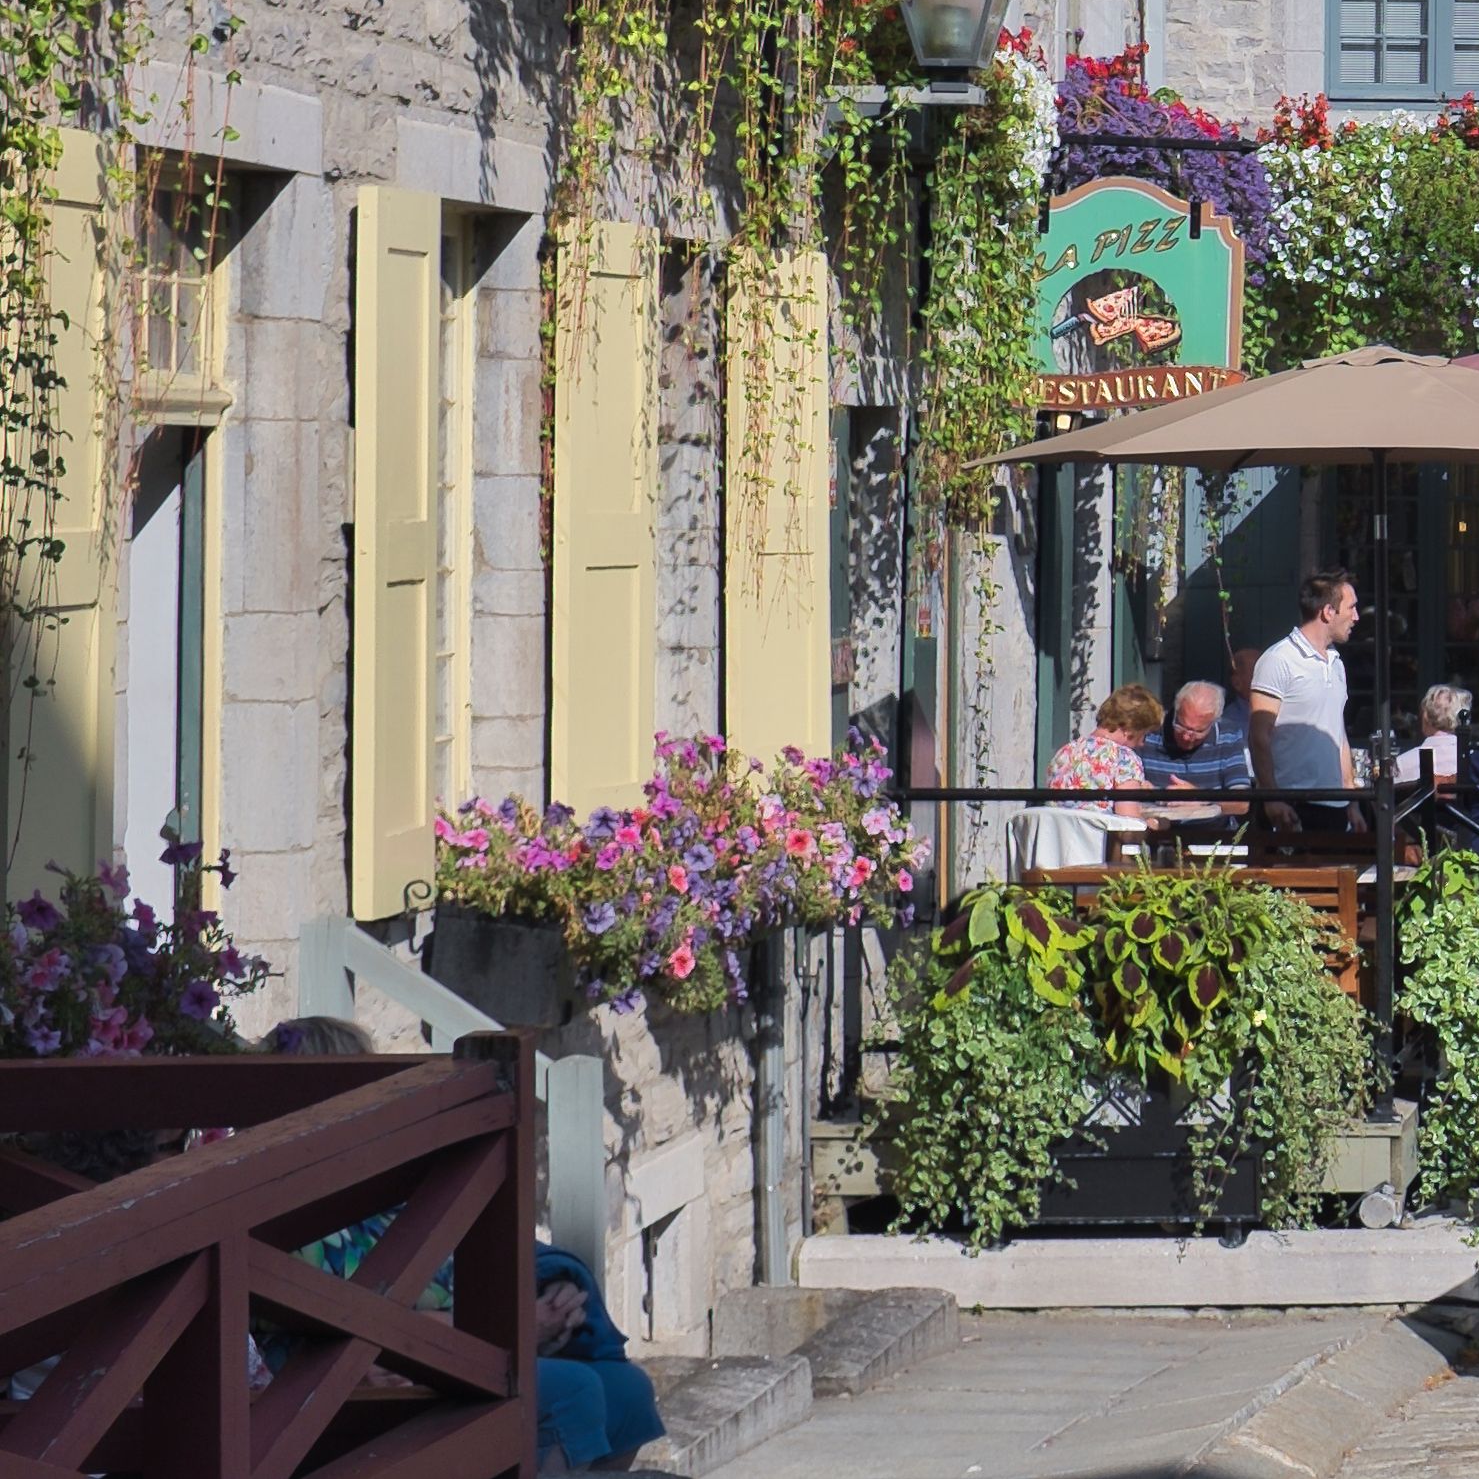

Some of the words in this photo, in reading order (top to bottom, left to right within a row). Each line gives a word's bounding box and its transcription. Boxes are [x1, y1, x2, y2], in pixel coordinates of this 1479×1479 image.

[1031, 244, 1078, 282] LA
[1091, 215, 1188, 263] PIZZ
[1025, 371, 1227, 406] ESTAURANT
